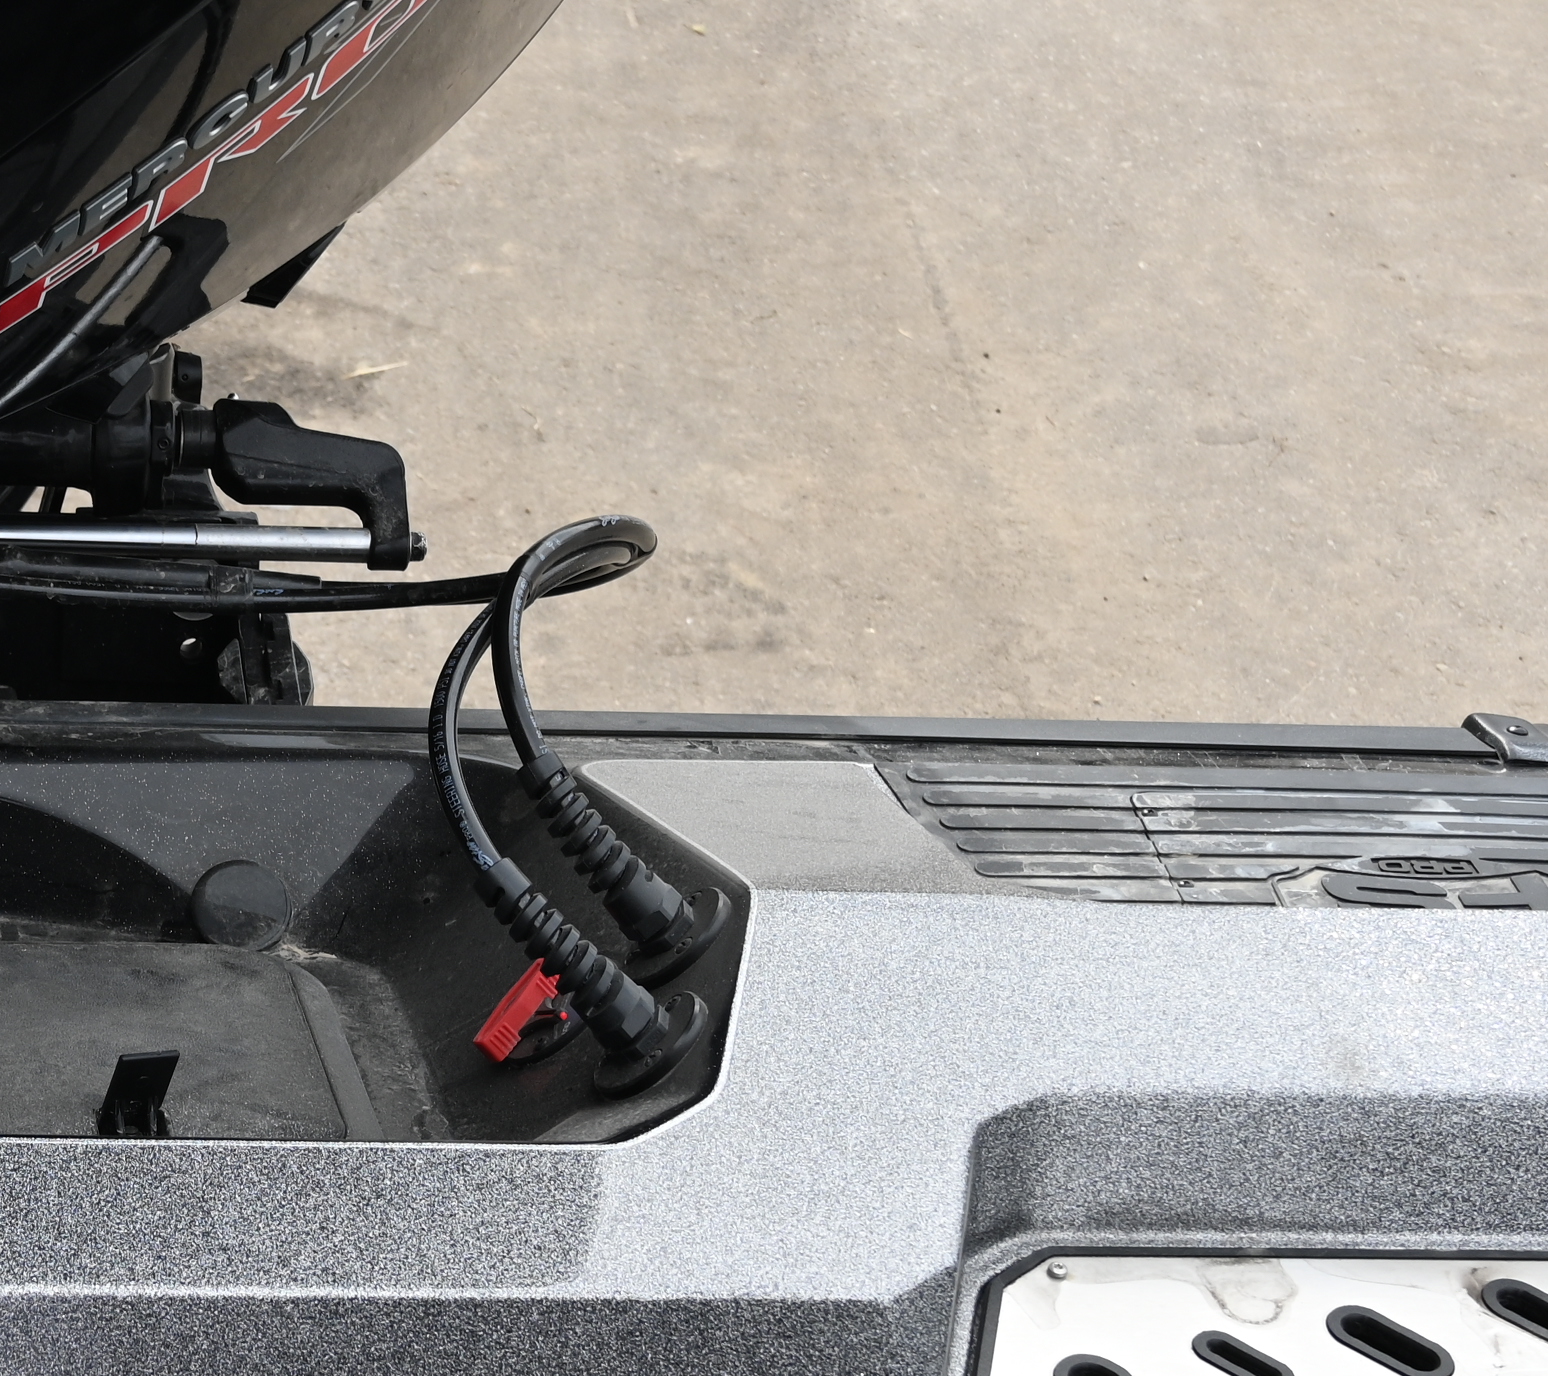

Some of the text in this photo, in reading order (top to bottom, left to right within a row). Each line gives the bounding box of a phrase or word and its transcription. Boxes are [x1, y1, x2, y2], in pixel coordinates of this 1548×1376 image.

[433, 730, 445, 753] 5/16
[435, 753, 450, 775] HOSE
[441, 775, 467, 819] STEERING
[1377, 859, 1474, 874] PRO
